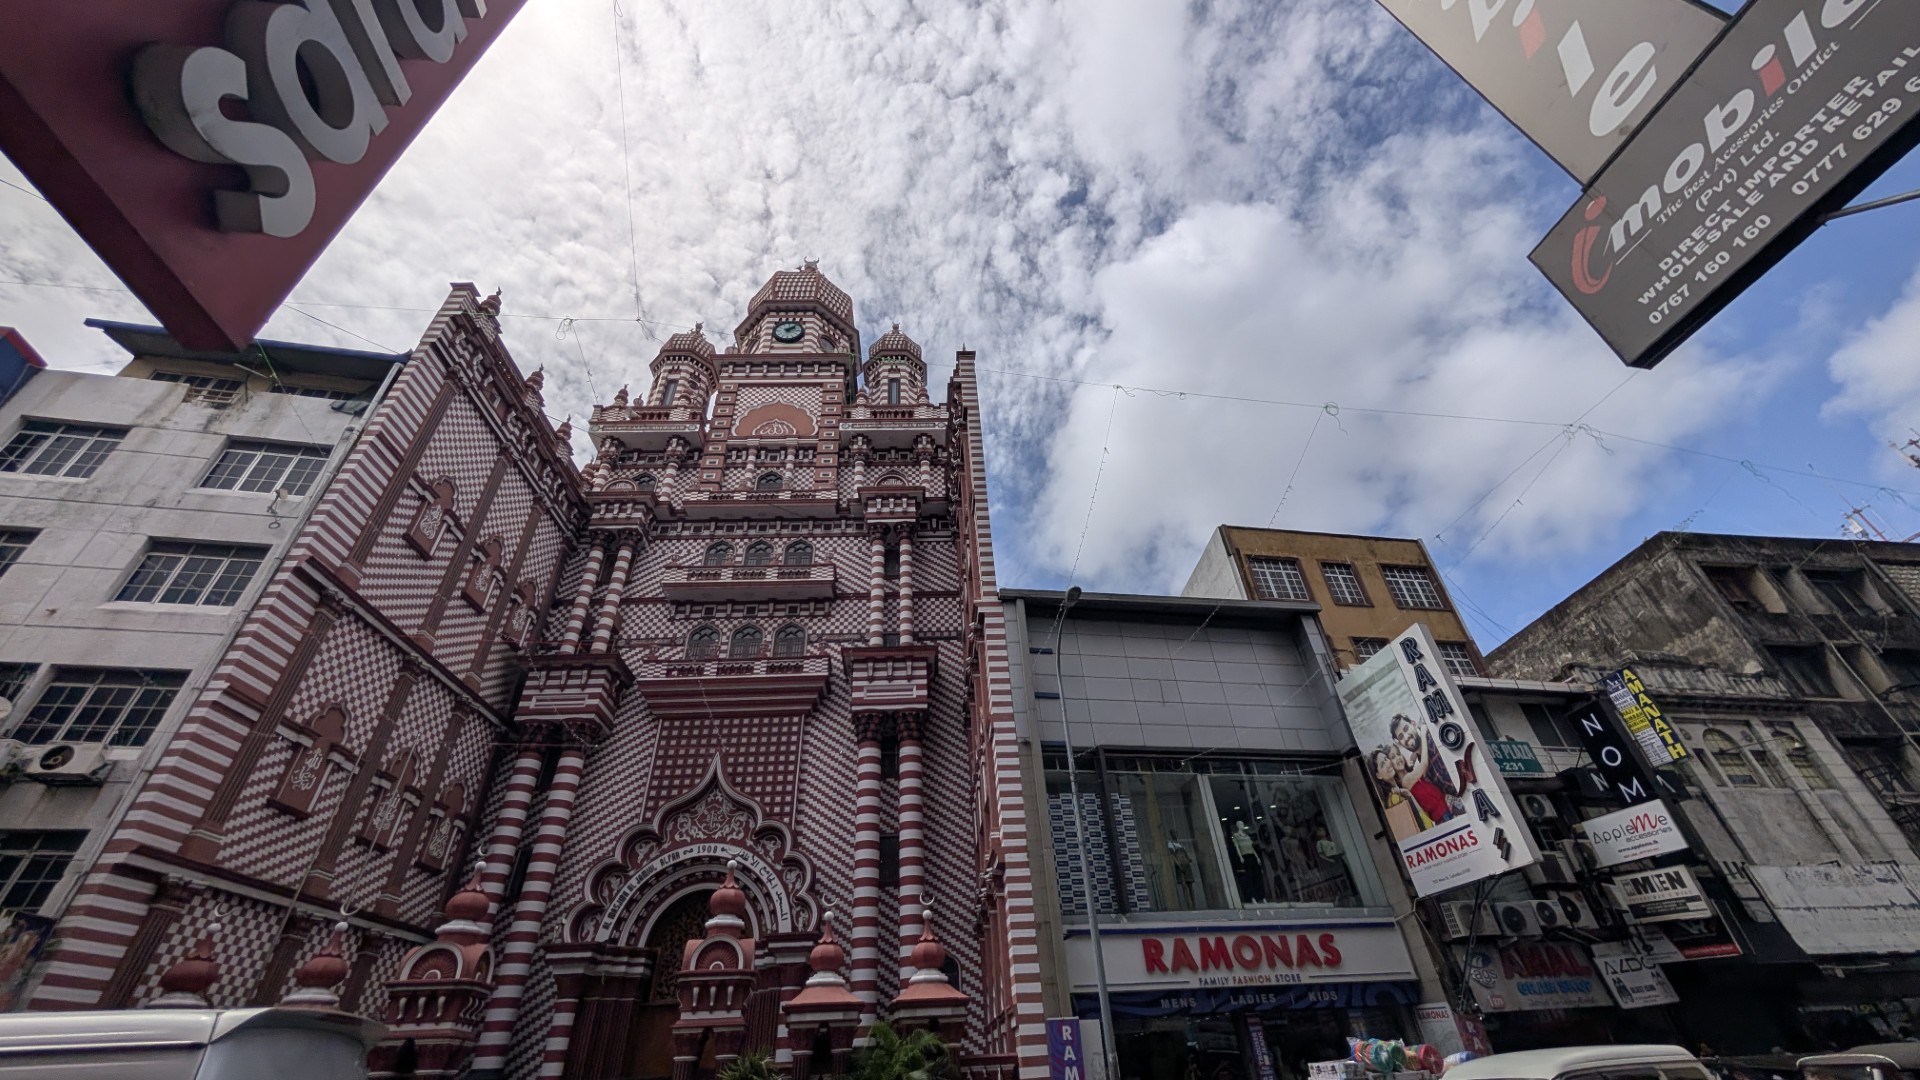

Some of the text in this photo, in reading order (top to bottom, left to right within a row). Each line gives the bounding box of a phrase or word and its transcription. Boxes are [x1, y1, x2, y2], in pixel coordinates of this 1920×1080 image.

[1656, 41, 1841, 225] The best Acessories Outlet
[1791, 143, 1849, 195] 0777
[1852, 97, 1902, 140] 629
[1637, 46, 1920, 305] WHOLESALE AND RETAIL
[1658, 76, 1868, 271] DIRECT IMPORTER
[1695, 131, 1781, 212] (Pvt) Ltd.
[1648, 213, 1773, 324] 0767 160 160
[1623, 668, 1687, 760] AMANATH
[697, 842, 718, 854] 1908
[1405, 830, 1478, 869] RAMONAS
[1593, 813, 1668, 844] AppleMe
[1626, 827, 1672, 843] accessories
[1141, 933, 1342, 974] RAMONAS
[1198, 973, 1302, 986] FAMILY FASHION STORE
[1161, 991, 1339, 1009] MENS LADIES KIDS
